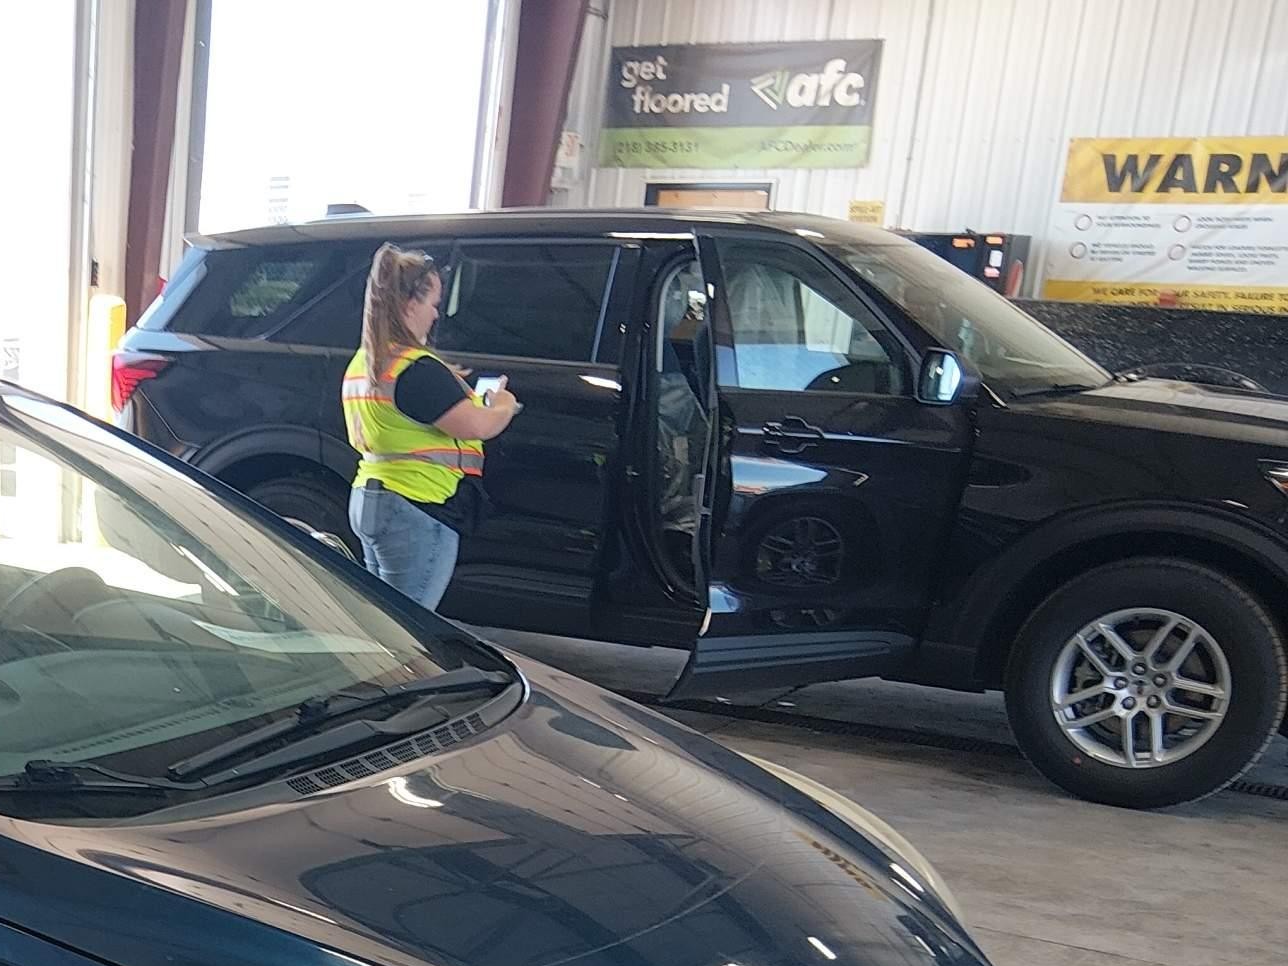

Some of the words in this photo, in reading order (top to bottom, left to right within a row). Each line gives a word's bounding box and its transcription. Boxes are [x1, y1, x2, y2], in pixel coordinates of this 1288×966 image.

[620, 56, 668, 88] get
[785, 58, 865, 108] afc
[631, 83, 731, 114] floored
[1101, 152, 1288, 194] WARN
